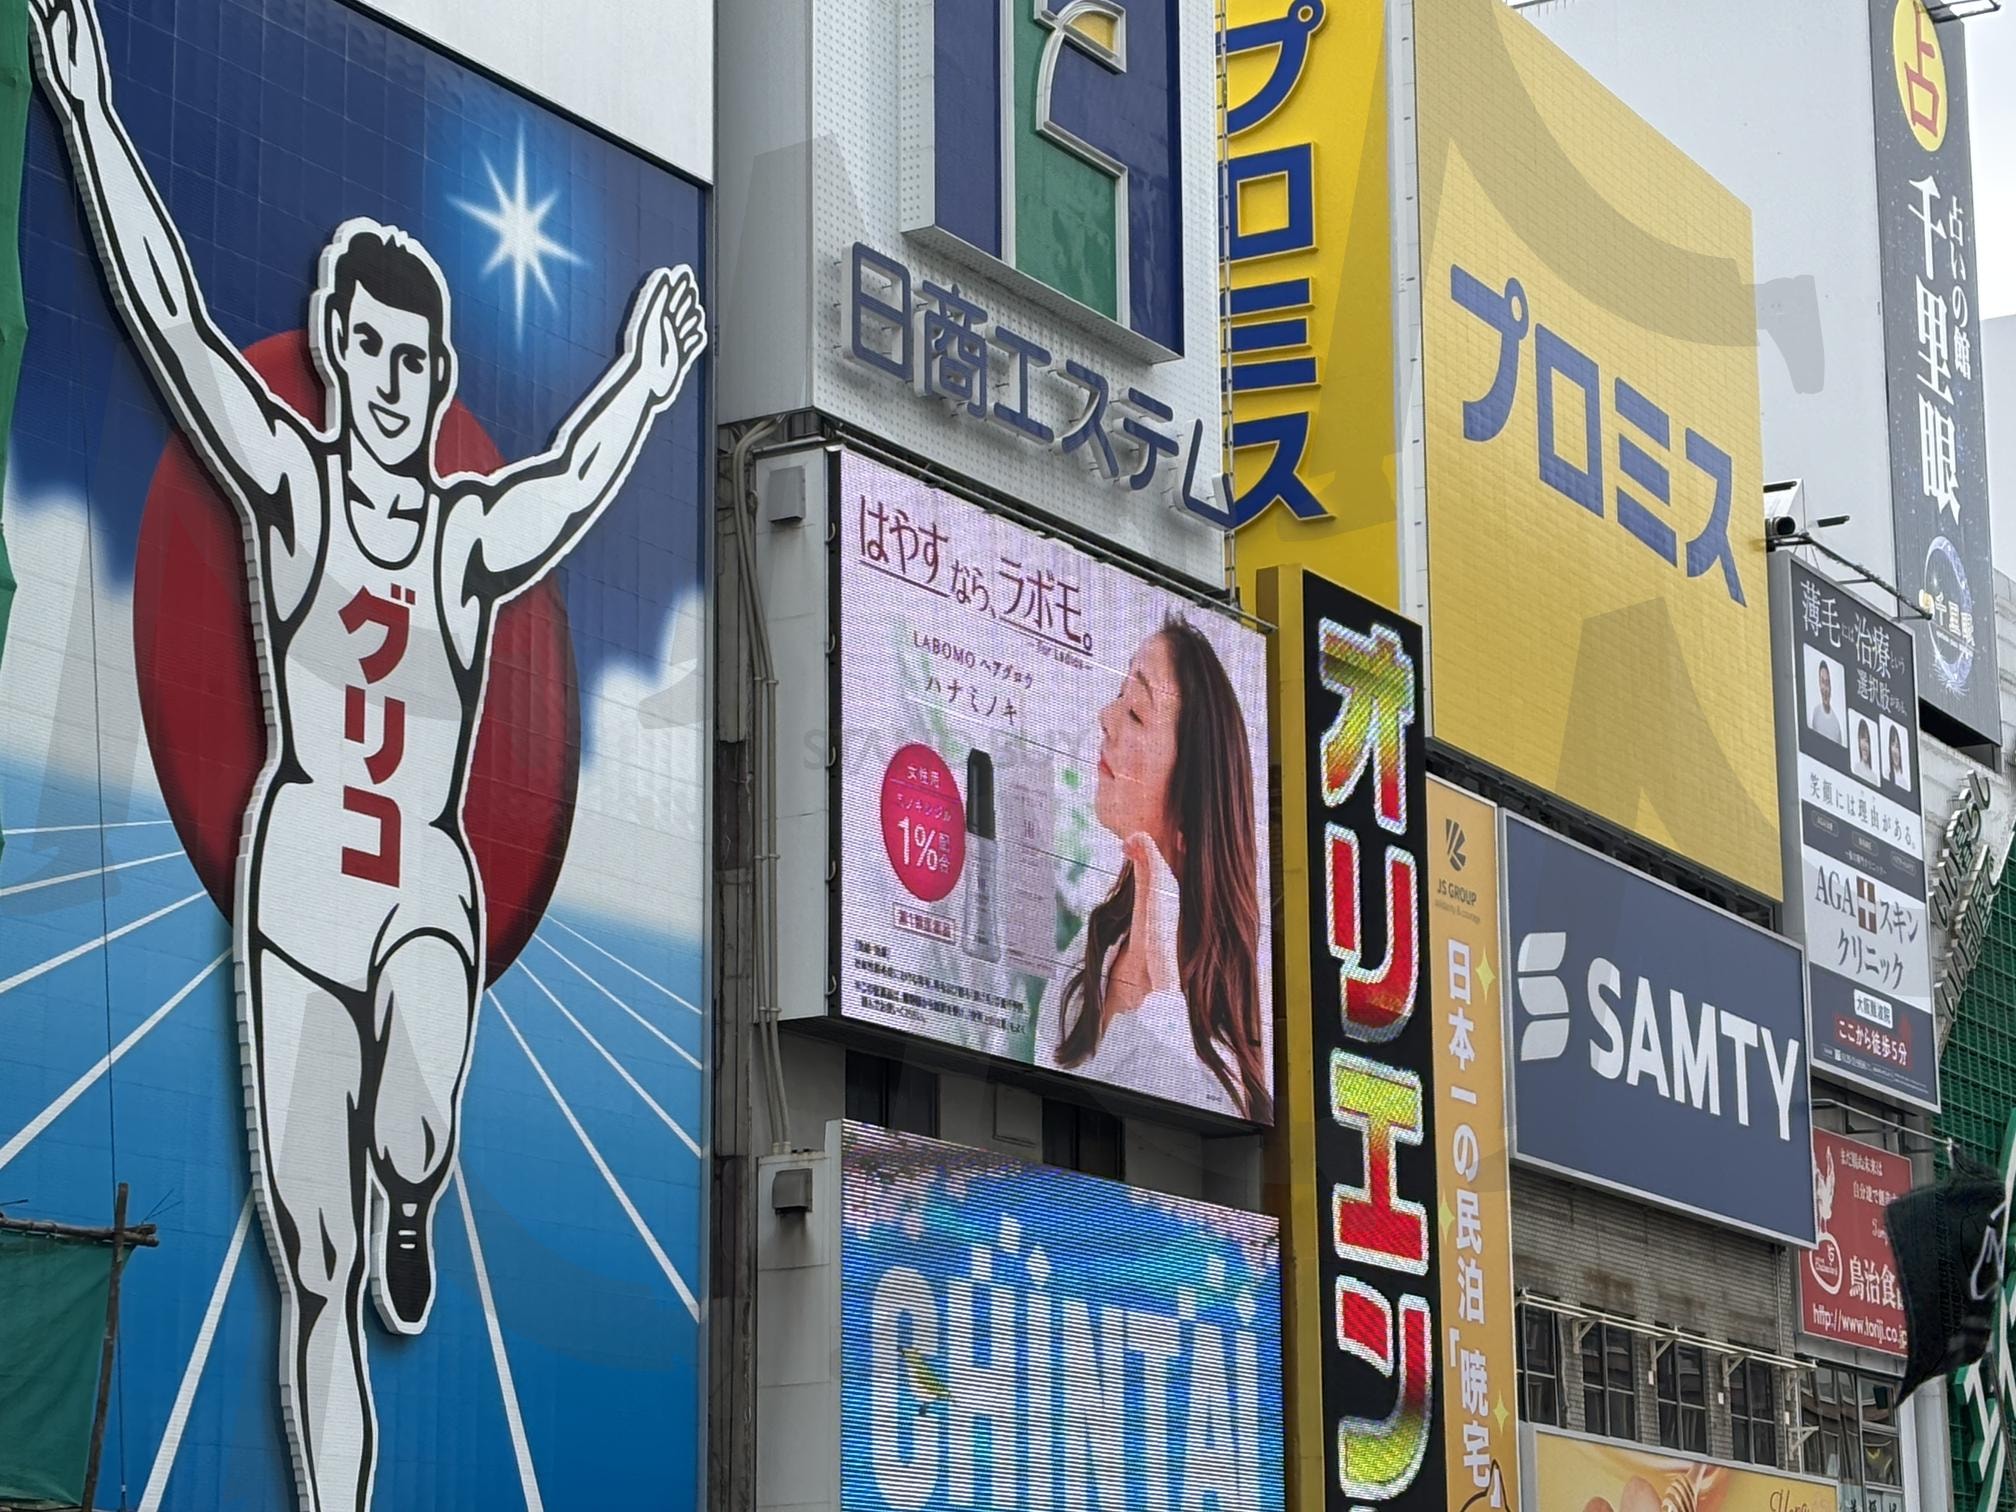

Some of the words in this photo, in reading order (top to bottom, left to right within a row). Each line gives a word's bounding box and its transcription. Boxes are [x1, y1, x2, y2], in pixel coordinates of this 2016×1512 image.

[1904, 0, 1940, 137] 占
[1215, 0, 1336, 524] プロミス
[849, 240, 1237, 530] 日商エステム
[1908, 175, 1961, 526] 千里眼
[1450, 263, 1747, 608] プロミス
[913, 630, 976, 668] LABOMO
[925, 675, 1018, 726] ハナミノキ
[338, 582, 416, 888] グリコ
[1437, 878, 1447, 896] JS
[1448, 882, 1477, 906] GROUP
[1814, 864, 1857, 918] AGA
[1838, 927, 1904, 990] クリニック
[1879, 899, 1918, 944] スキン
[1318, 616, 1433, 1512] オリエン
[1587, 957, 1800, 1141] SAMTY
[1839, 1019, 1908, 1067] ここから徒歩5分
